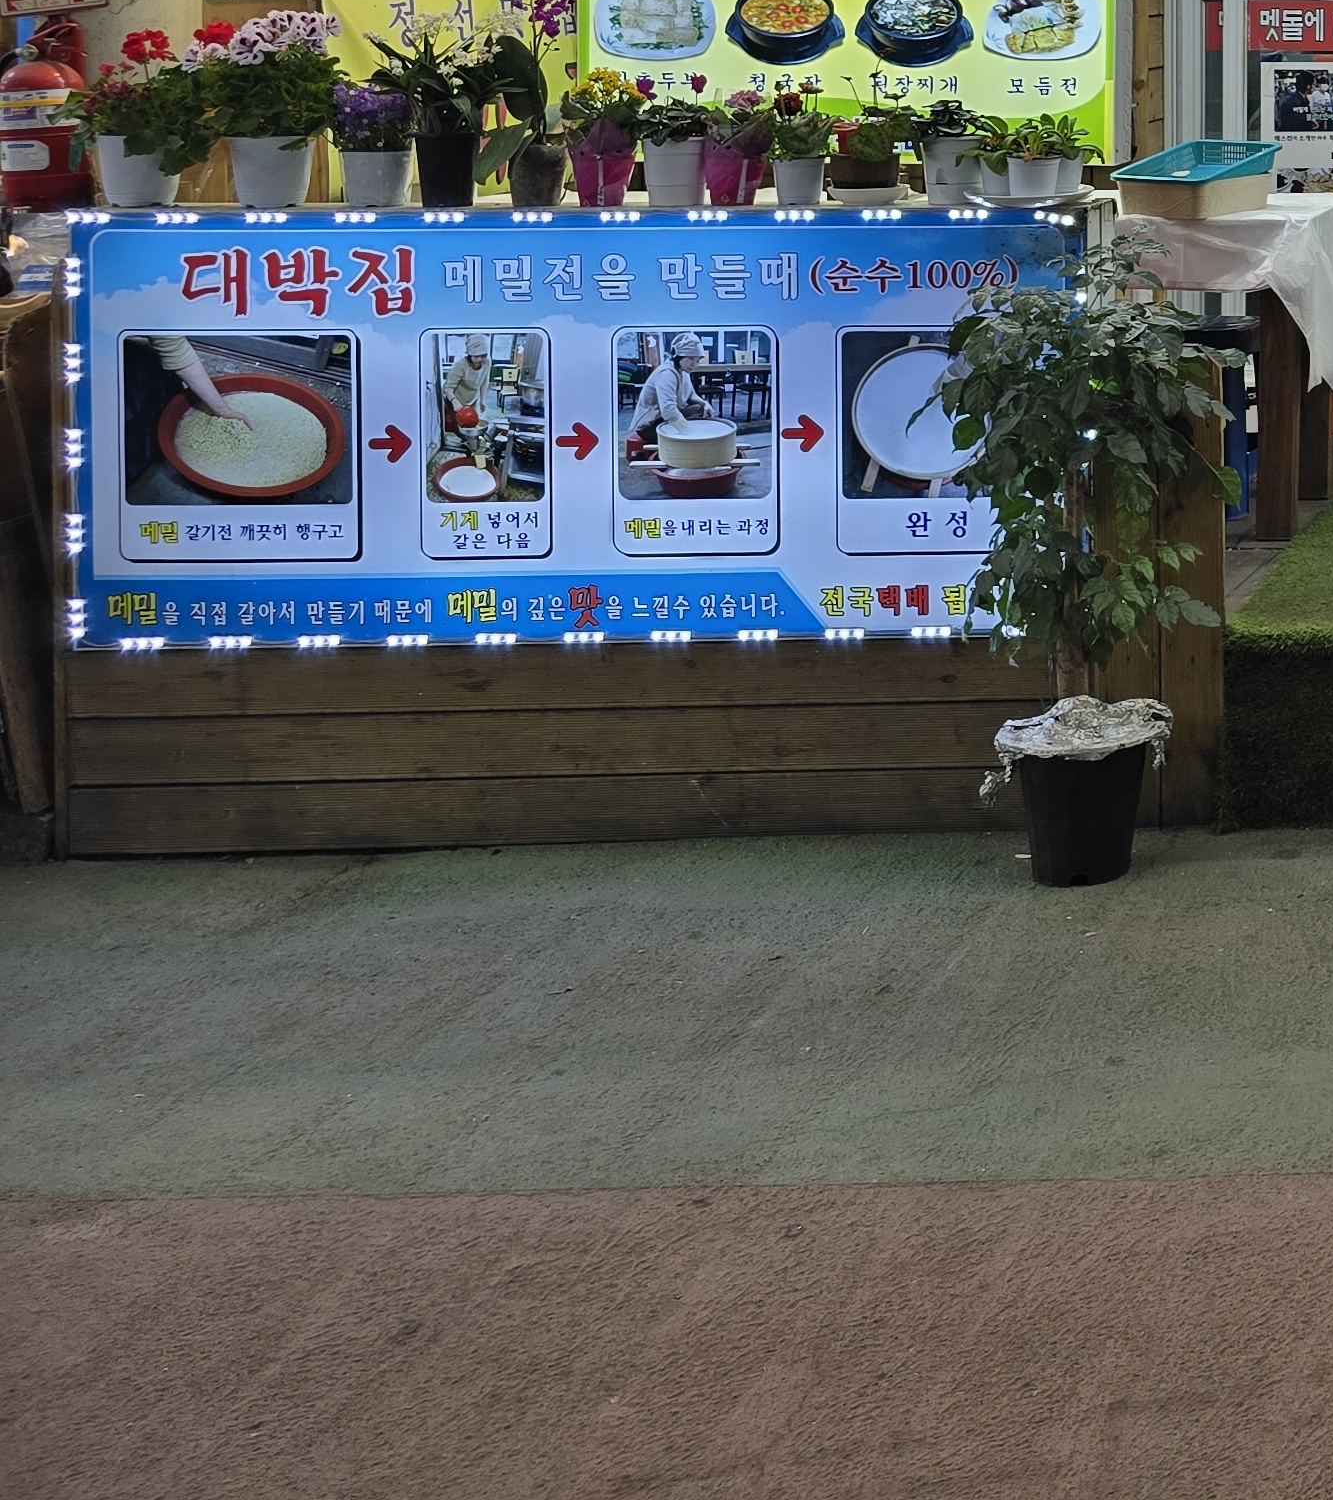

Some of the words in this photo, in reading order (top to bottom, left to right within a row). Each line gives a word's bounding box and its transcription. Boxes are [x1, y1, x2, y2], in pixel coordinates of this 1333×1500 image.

[1259, 8, 1325, 42] 멧돌에
[1006, 76, 1079, 97] 모듬전
[180, 244, 417, 320] 대박집
[443, 253, 636, 303] 메밀전을
[657, 251, 800, 303] 만들때
[140, 521, 180, 545] 메밀
[185, 523, 233, 542] 갈기전
[240, 523, 287, 542] 깨끗히
[440, 510, 479, 531] 기계
[486, 510, 540, 530] 넣어서
[905, 510, 969, 539] 완성
[452, 532, 487, 550] 갈은
[496, 532, 532, 551] 다음
[189, 602, 227, 625] 직접
[237, 601, 296, 623] 갈아서
[306, 601, 365, 623] 만들기
[373, 599, 432, 623] 때문에
[528, 596, 564, 620] 깊은
[632, 596, 691, 620] 느낄수
[700, 593, 786, 619] 있습니다.
[819, 585, 930, 617] 전국택배
